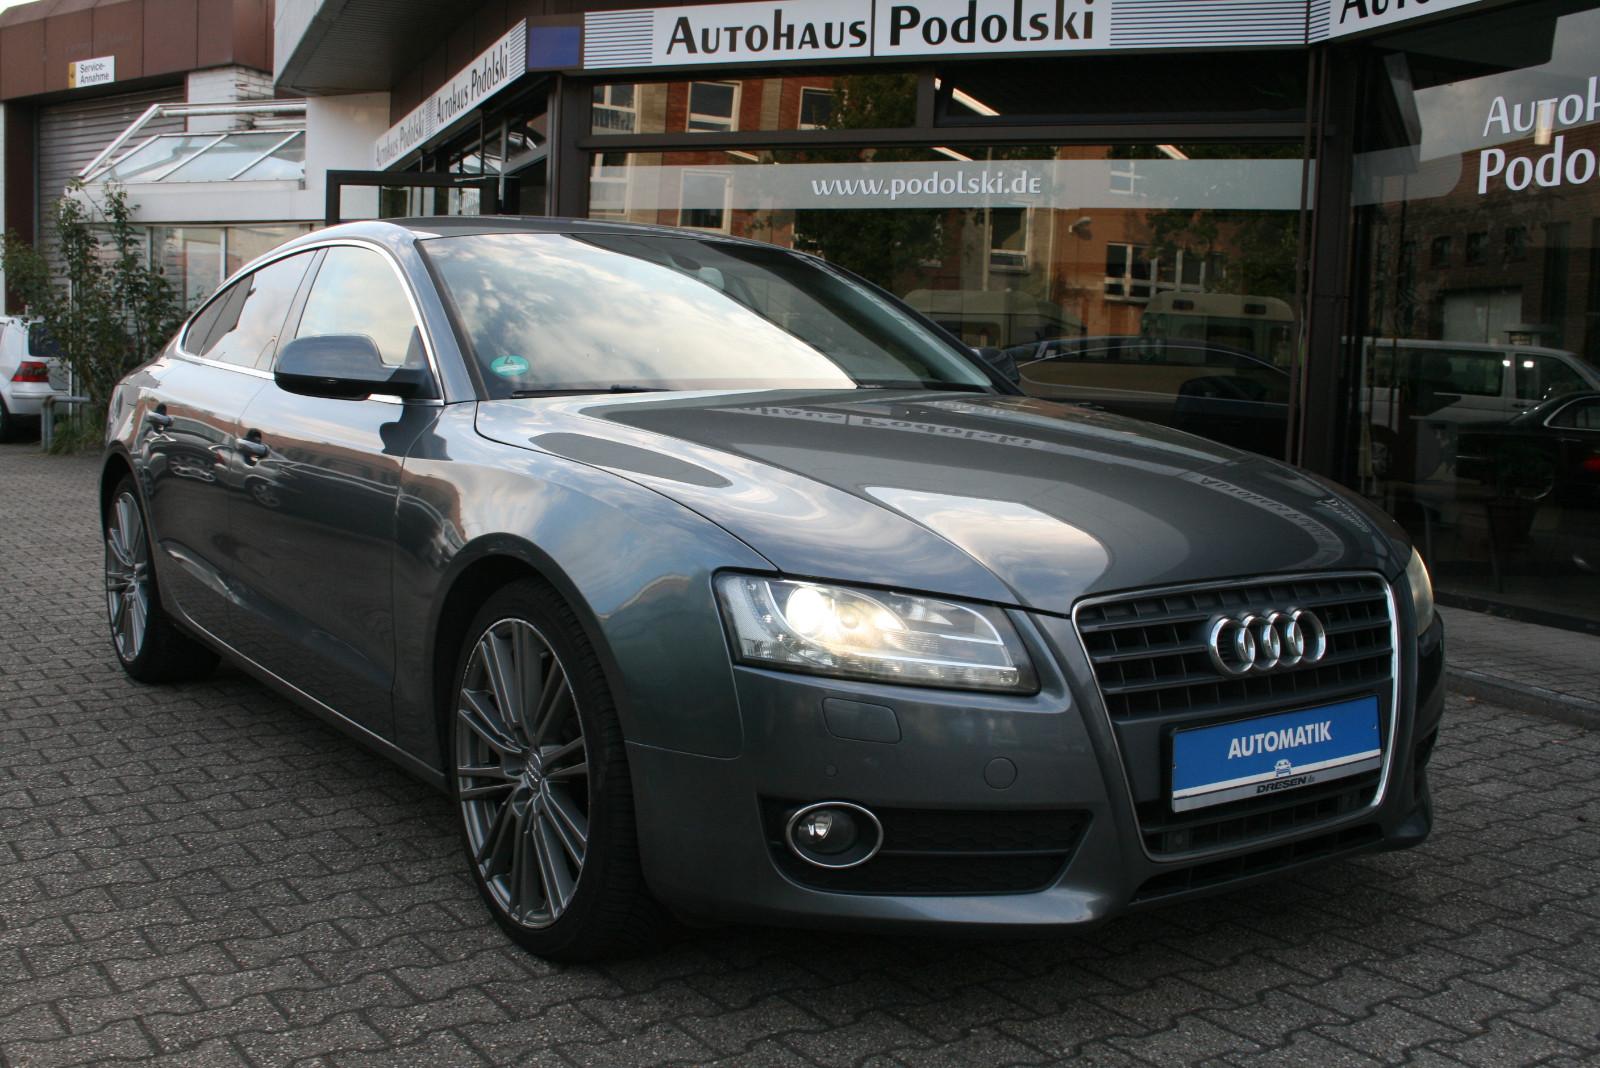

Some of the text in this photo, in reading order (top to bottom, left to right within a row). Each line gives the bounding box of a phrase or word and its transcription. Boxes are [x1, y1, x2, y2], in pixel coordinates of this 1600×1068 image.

[890, 0, 1094, 47] Podolski
[471, 41, 508, 101] Podolski
[1478, 135, 1600, 194] Podo
[1227, 720, 1332, 760] AUTOMATIK
[1256, 776, 1307, 794] DRESEN
